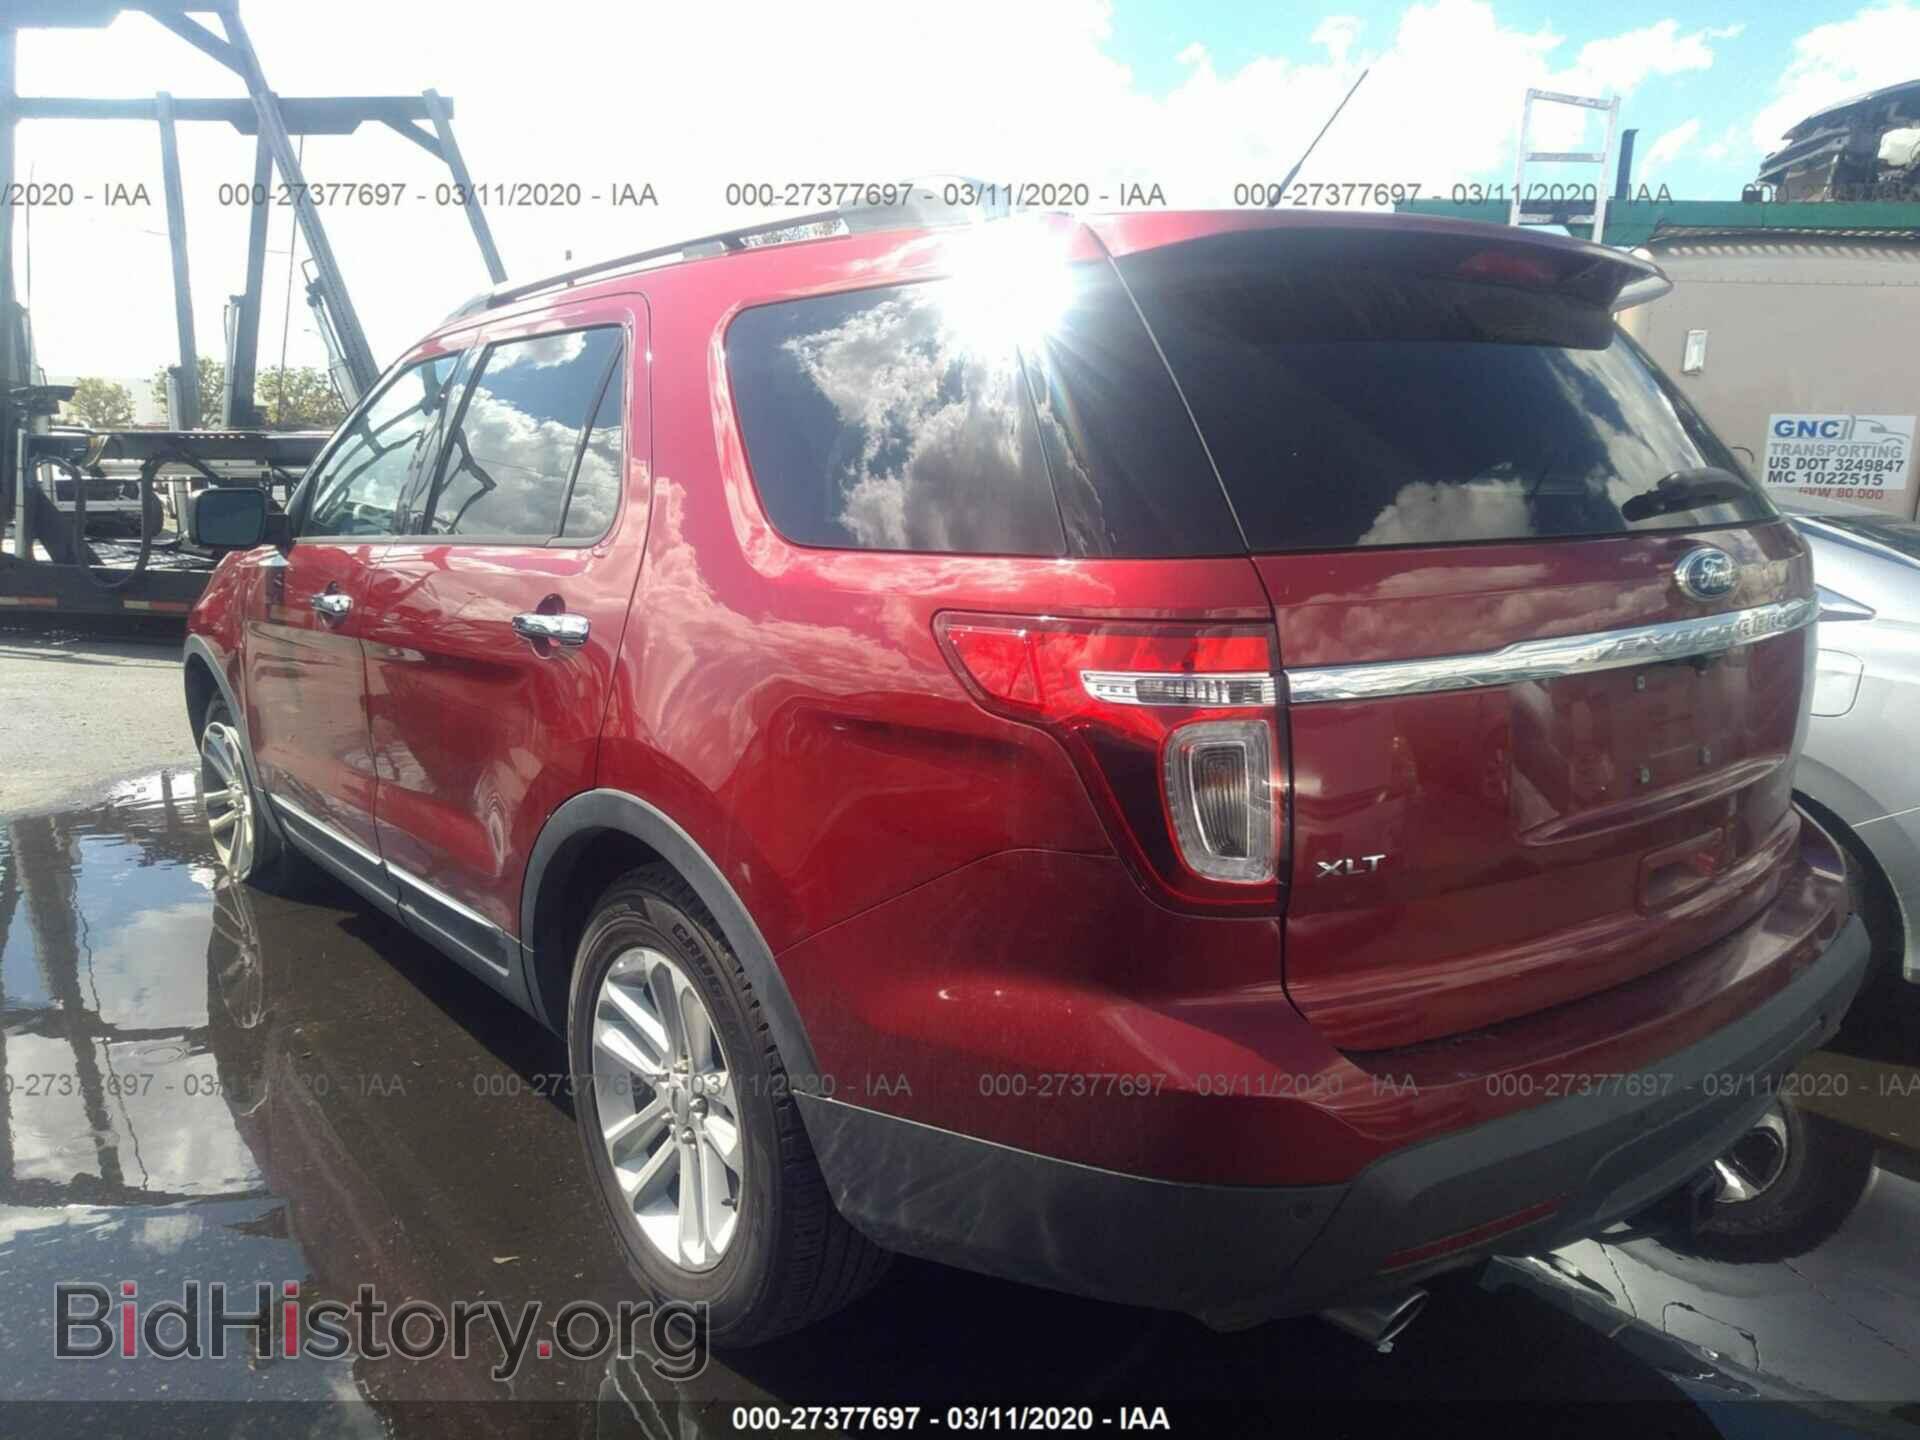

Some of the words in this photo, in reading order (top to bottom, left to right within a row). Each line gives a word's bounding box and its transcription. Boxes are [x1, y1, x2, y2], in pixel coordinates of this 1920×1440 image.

[1774, 420, 1840, 439] GNC
[1770, 442, 1903, 459] TRANSPORTING
[1768, 457, 1791, 470] US
[1796, 457, 1830, 471] DOT
[1834, 458, 1905, 473] 3249847
[1767, 470, 1797, 484] MC
[1803, 472, 1885, 487] 1022515
[1316, 853, 1386, 878] XLT
